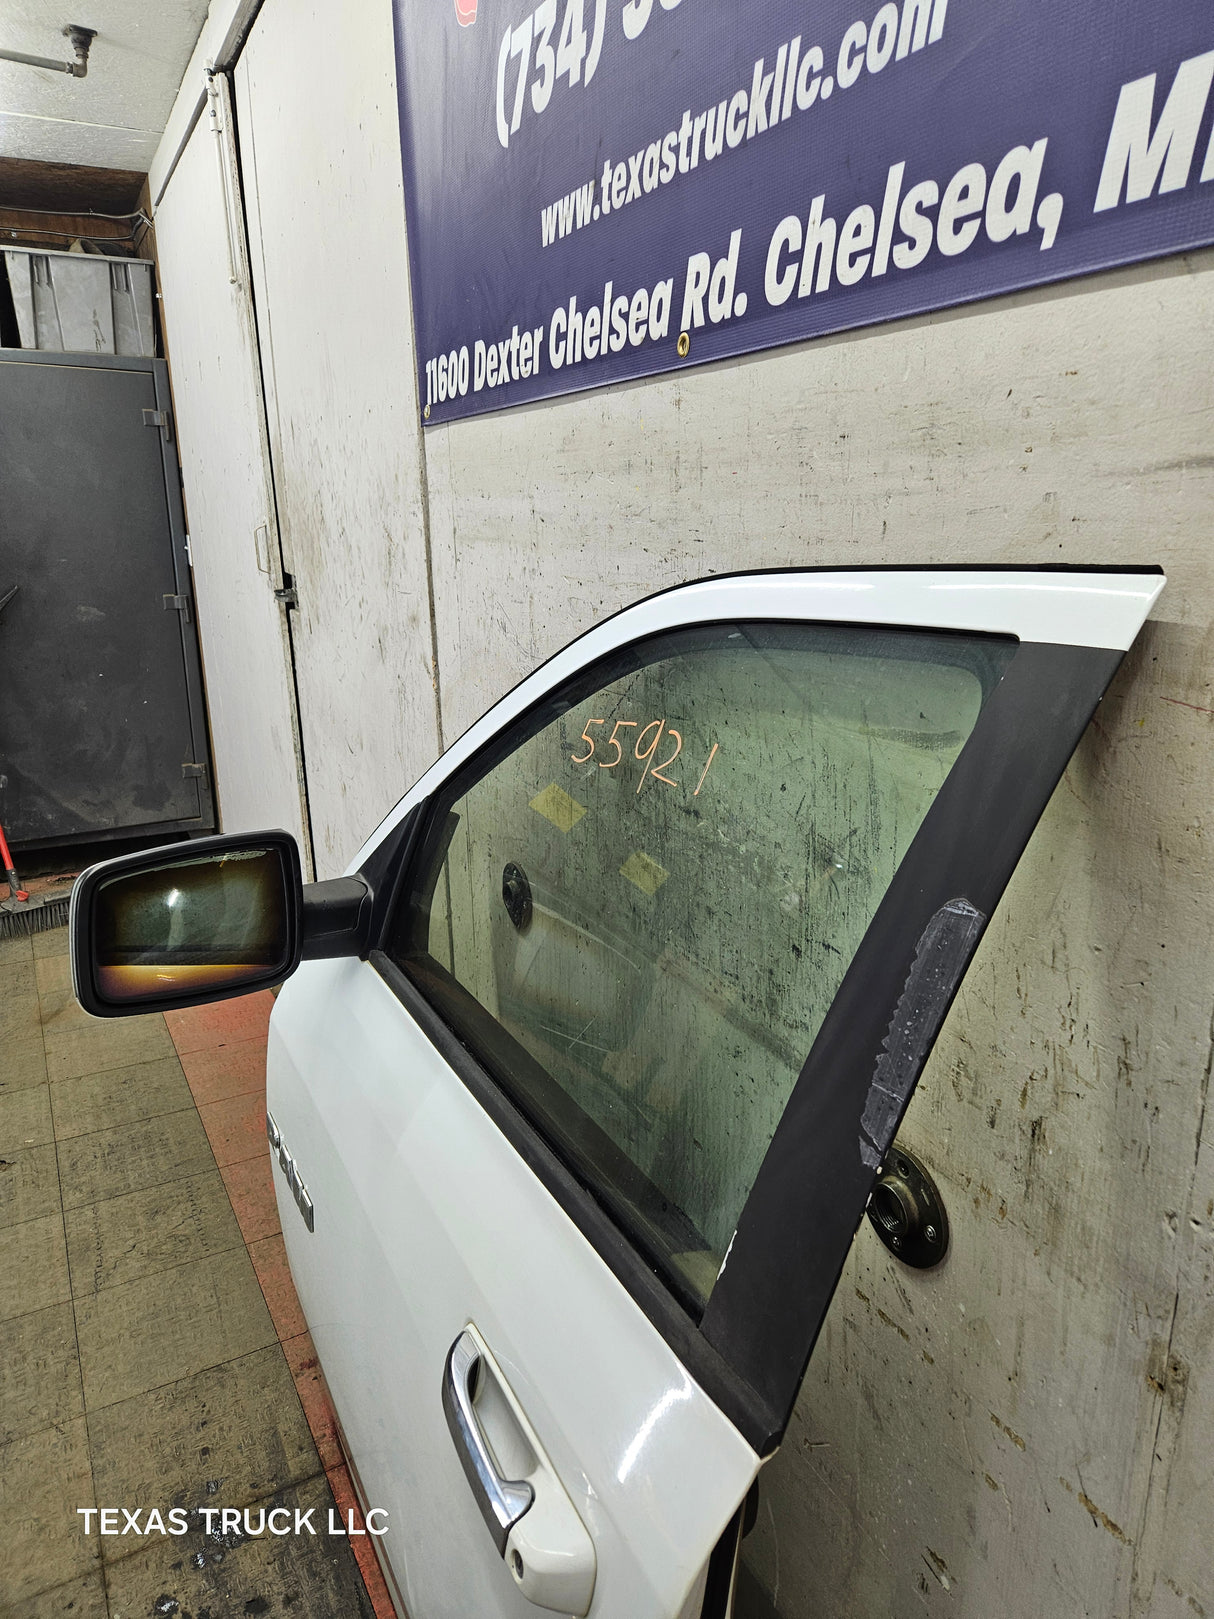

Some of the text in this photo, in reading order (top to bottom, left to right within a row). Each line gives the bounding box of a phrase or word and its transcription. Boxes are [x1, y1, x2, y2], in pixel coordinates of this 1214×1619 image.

[496, 0, 608, 148] (734)
[541, 0, 949, 248] www.texastruckllc.com
[425, 49, 1214, 406] 11600 Dexter Chelsea Rd. Chelsea, M
[570, 718, 720, 796] 55921
